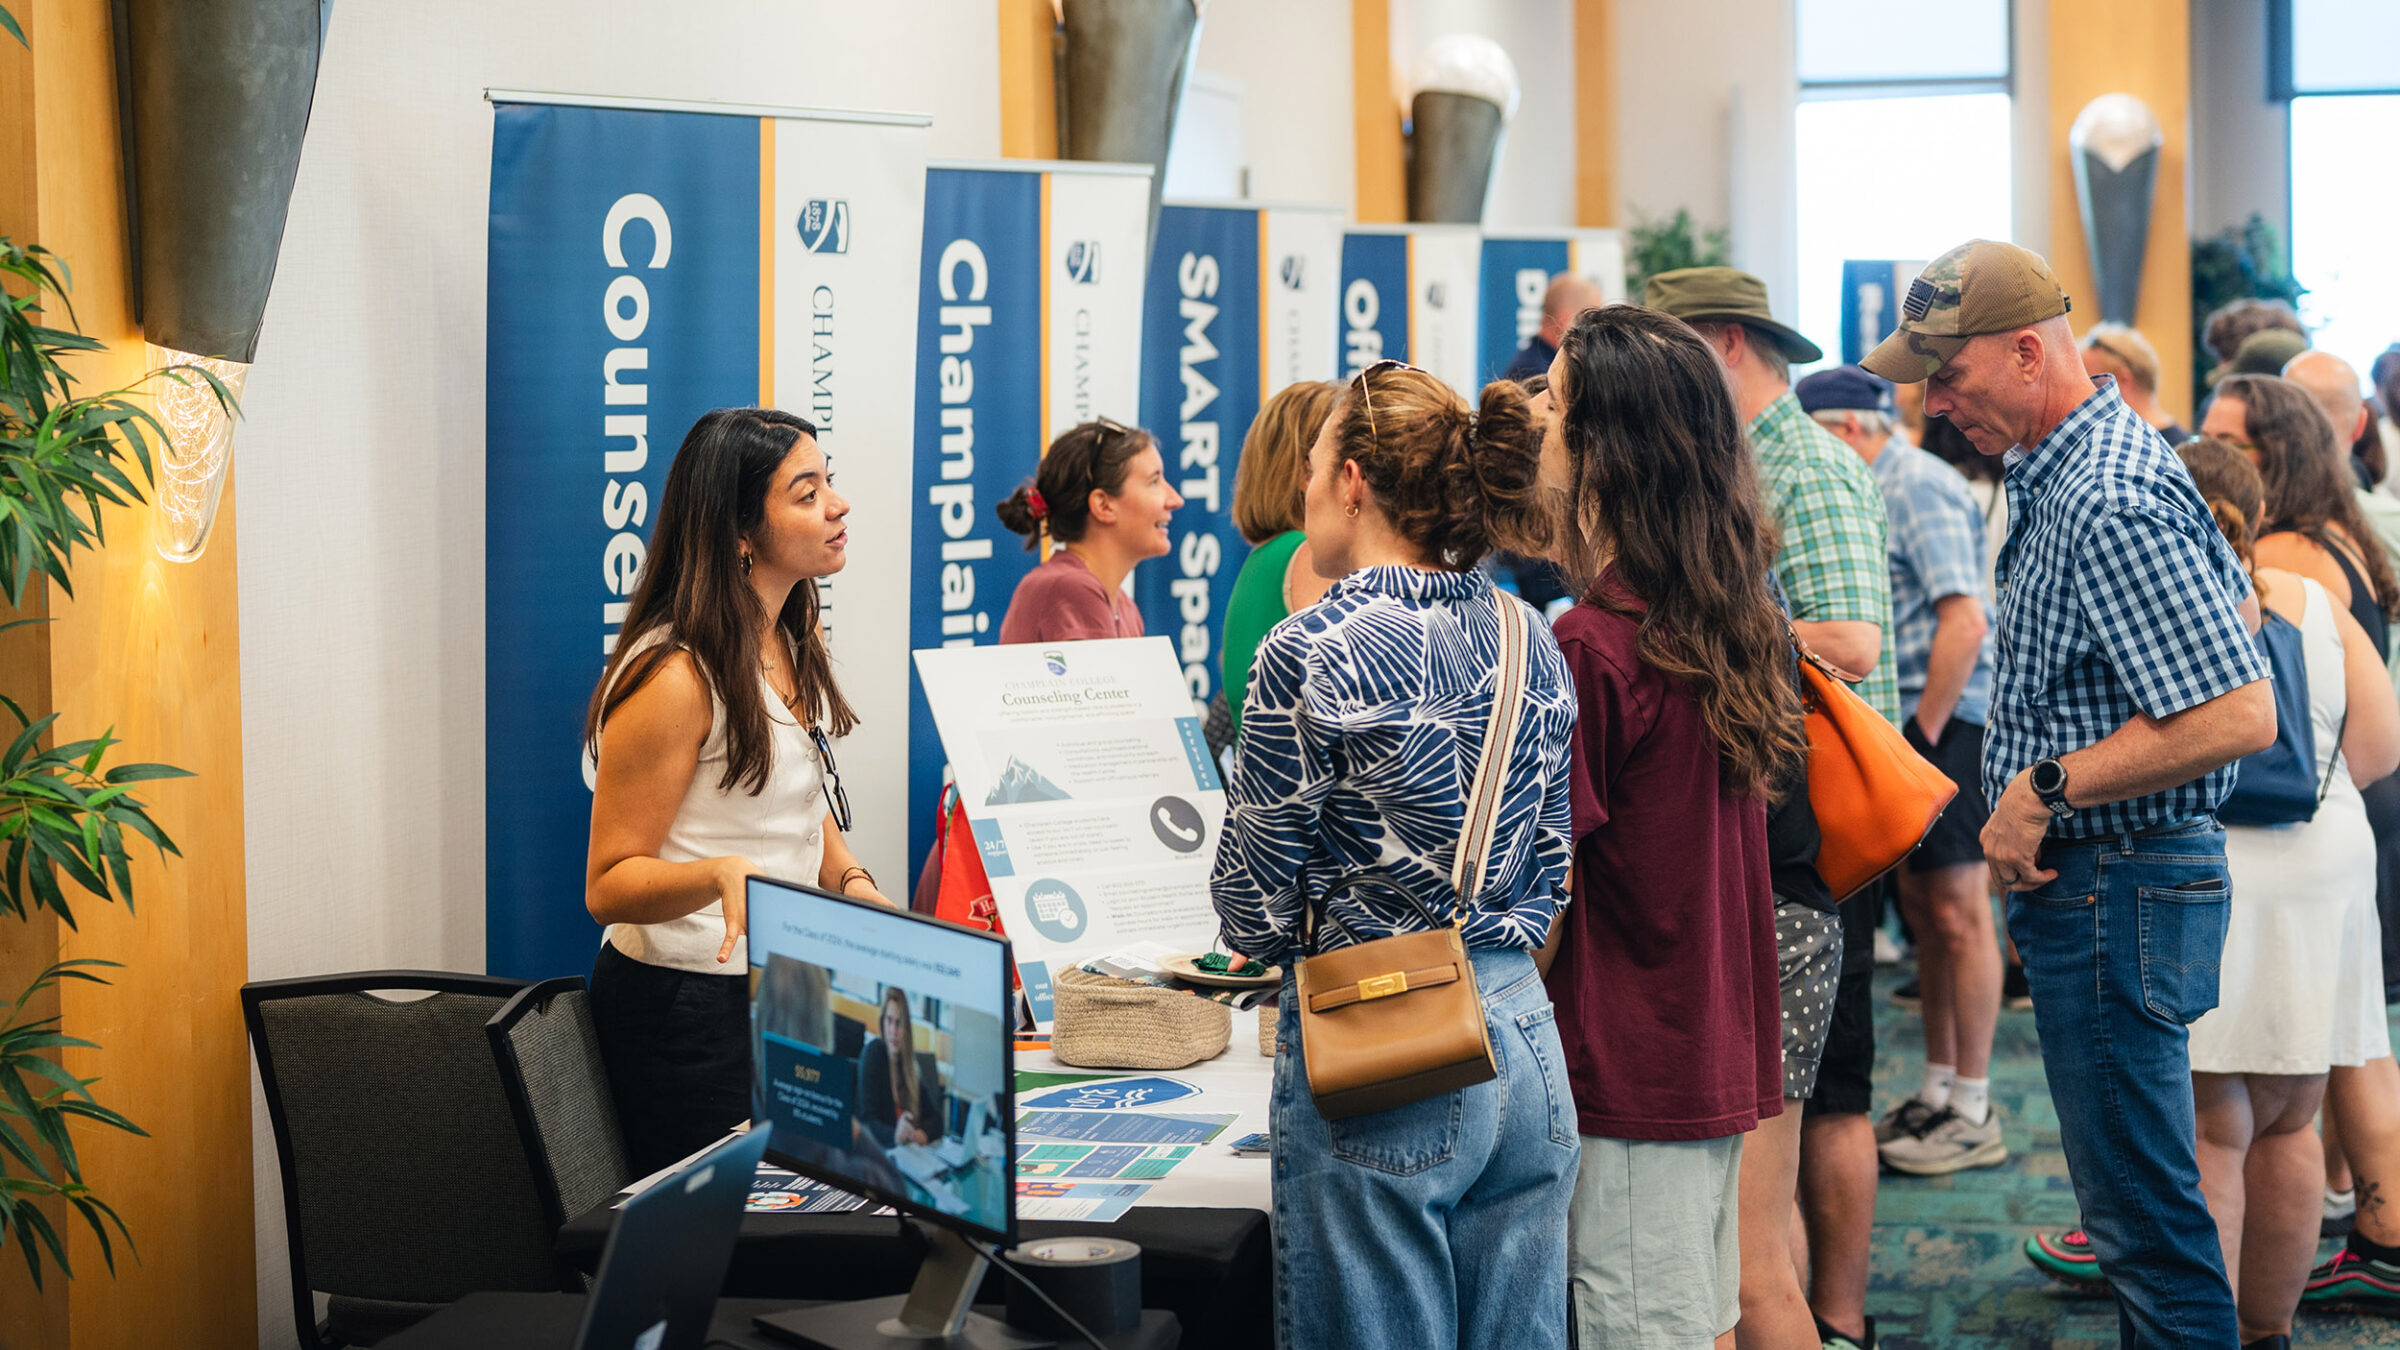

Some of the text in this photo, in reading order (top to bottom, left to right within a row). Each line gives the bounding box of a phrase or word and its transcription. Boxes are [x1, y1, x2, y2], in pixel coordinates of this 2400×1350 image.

[929, 238, 993, 649] Champlai
[1075, 308, 1091, 425] CHAMP
[1178, 251, 1222, 513] SMART
[1001, 687, 1130, 706] Counseling Center
